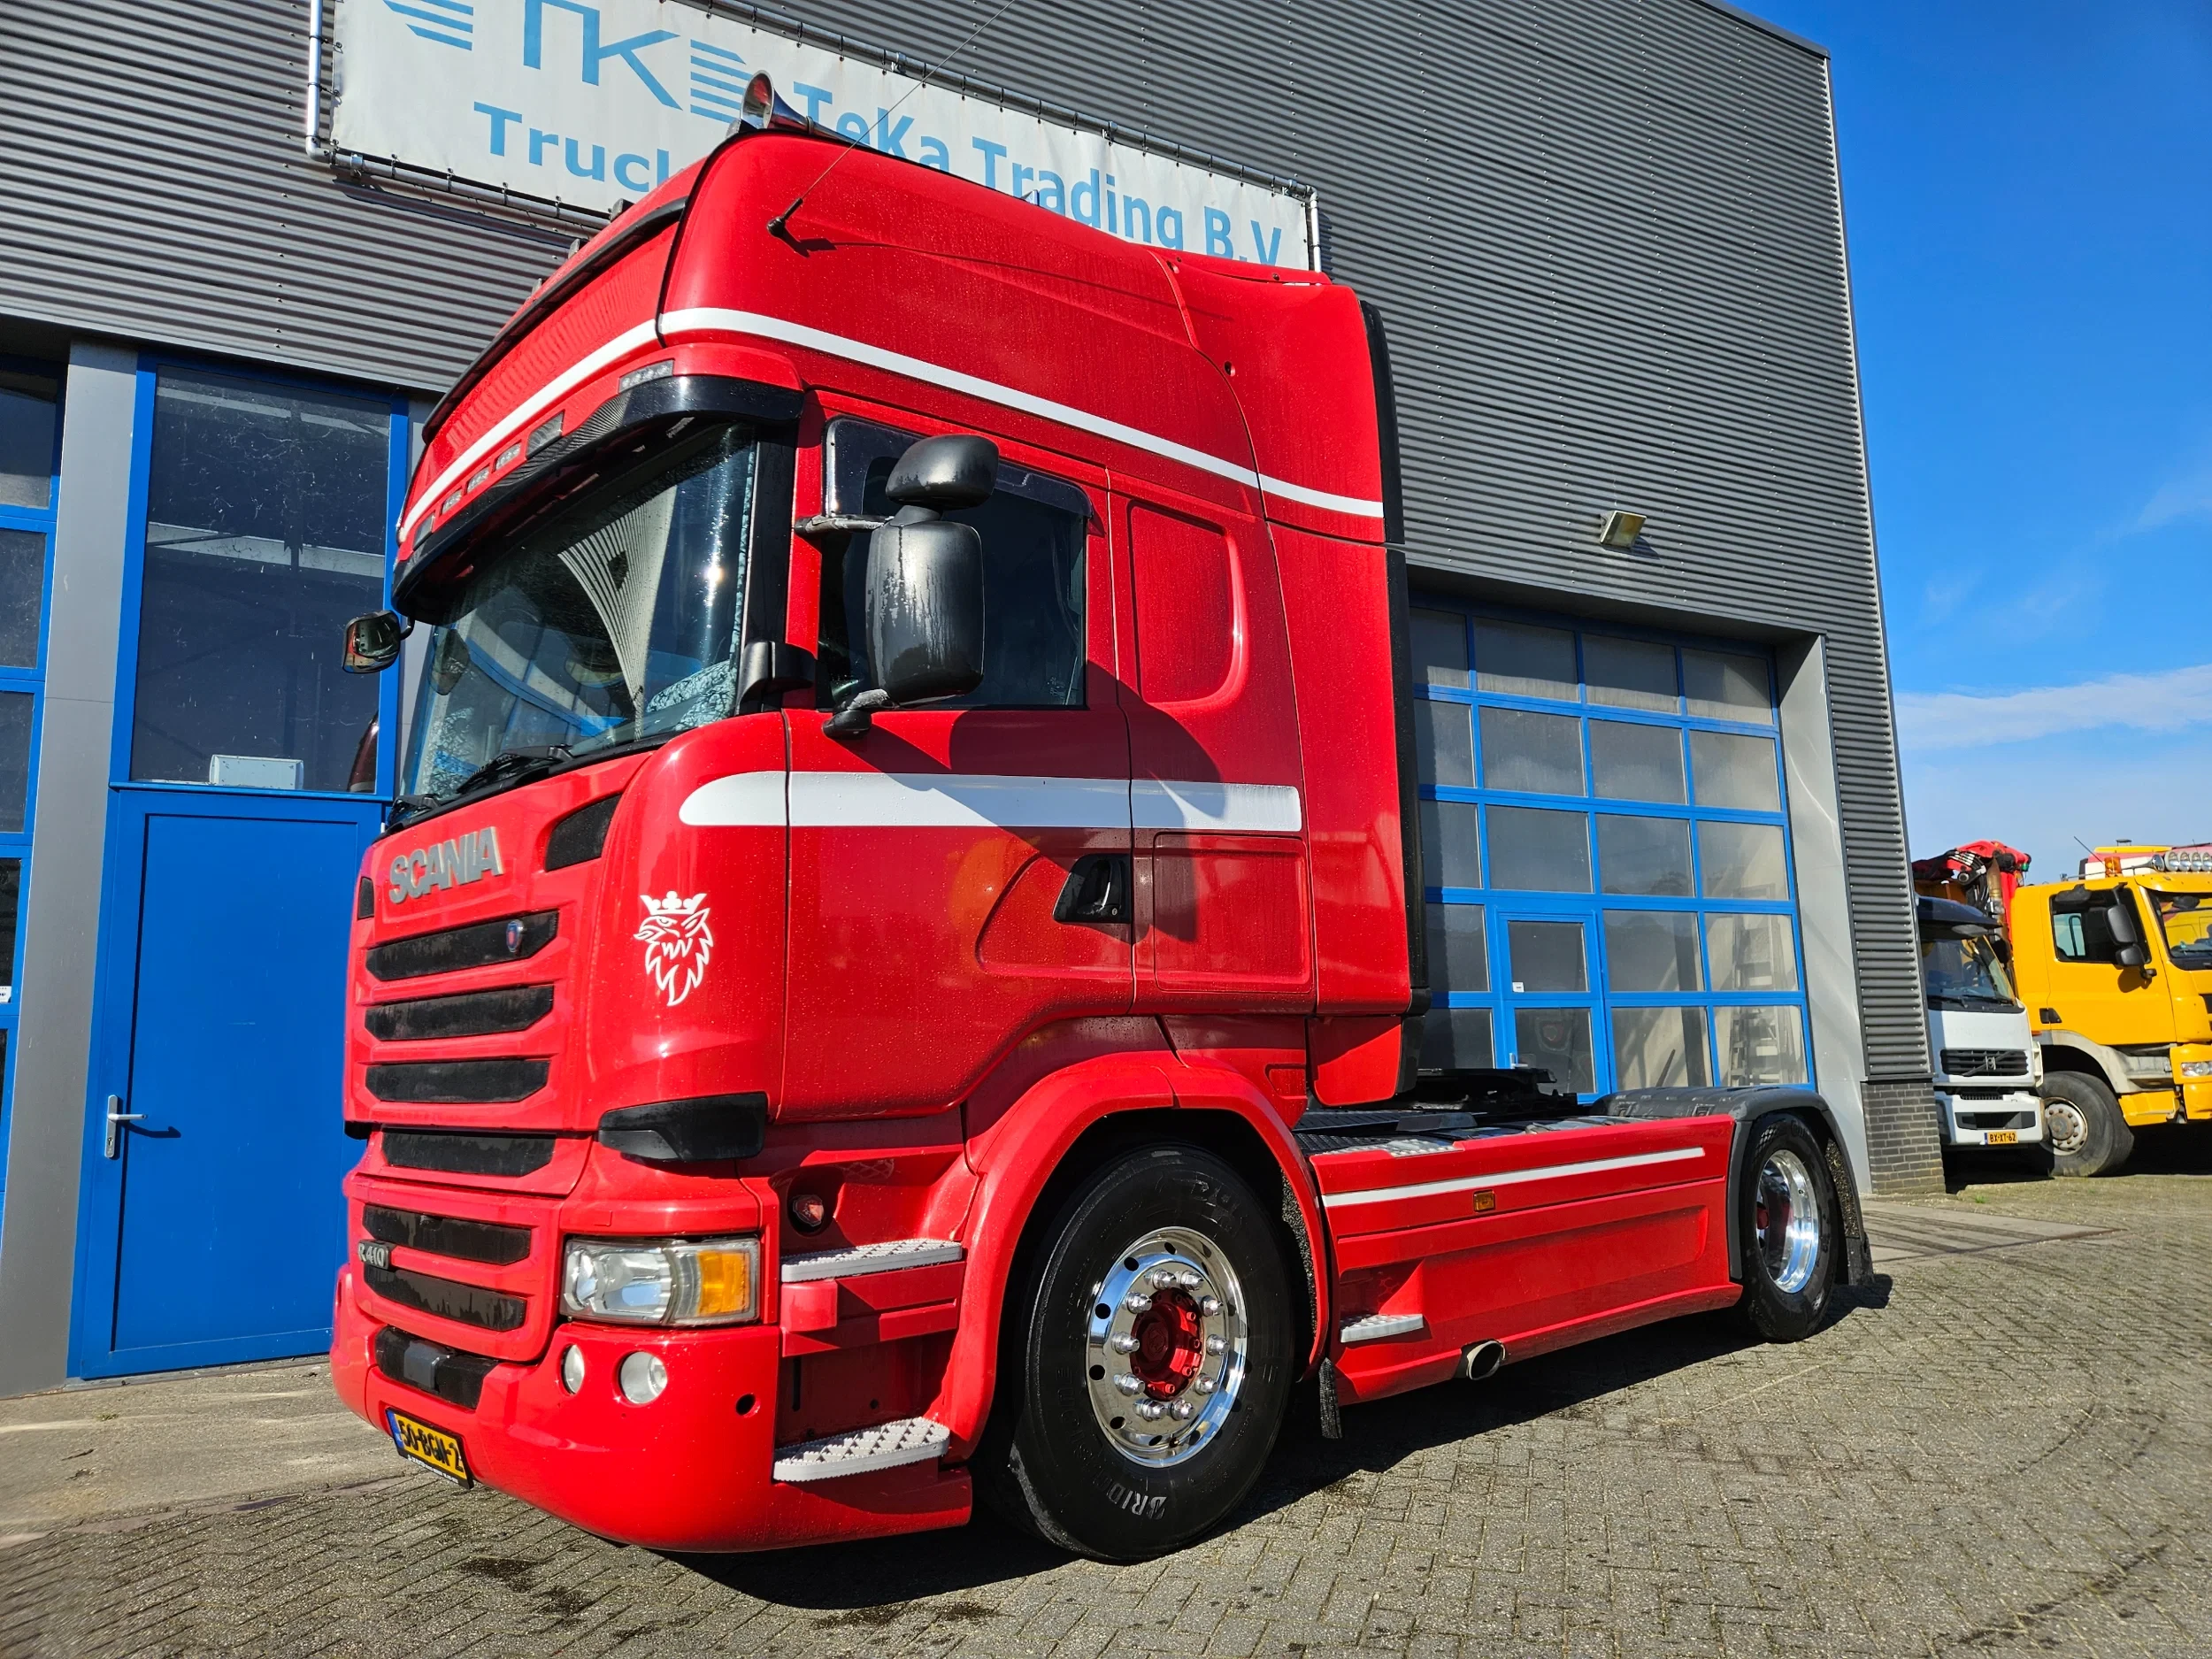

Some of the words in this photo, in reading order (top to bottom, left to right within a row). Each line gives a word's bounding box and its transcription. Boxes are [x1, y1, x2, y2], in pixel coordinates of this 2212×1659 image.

[793, 81, 949, 173] TeKa
[972, 135, 1184, 251] Trading
[389, 826, 504, 904] SCANIA
